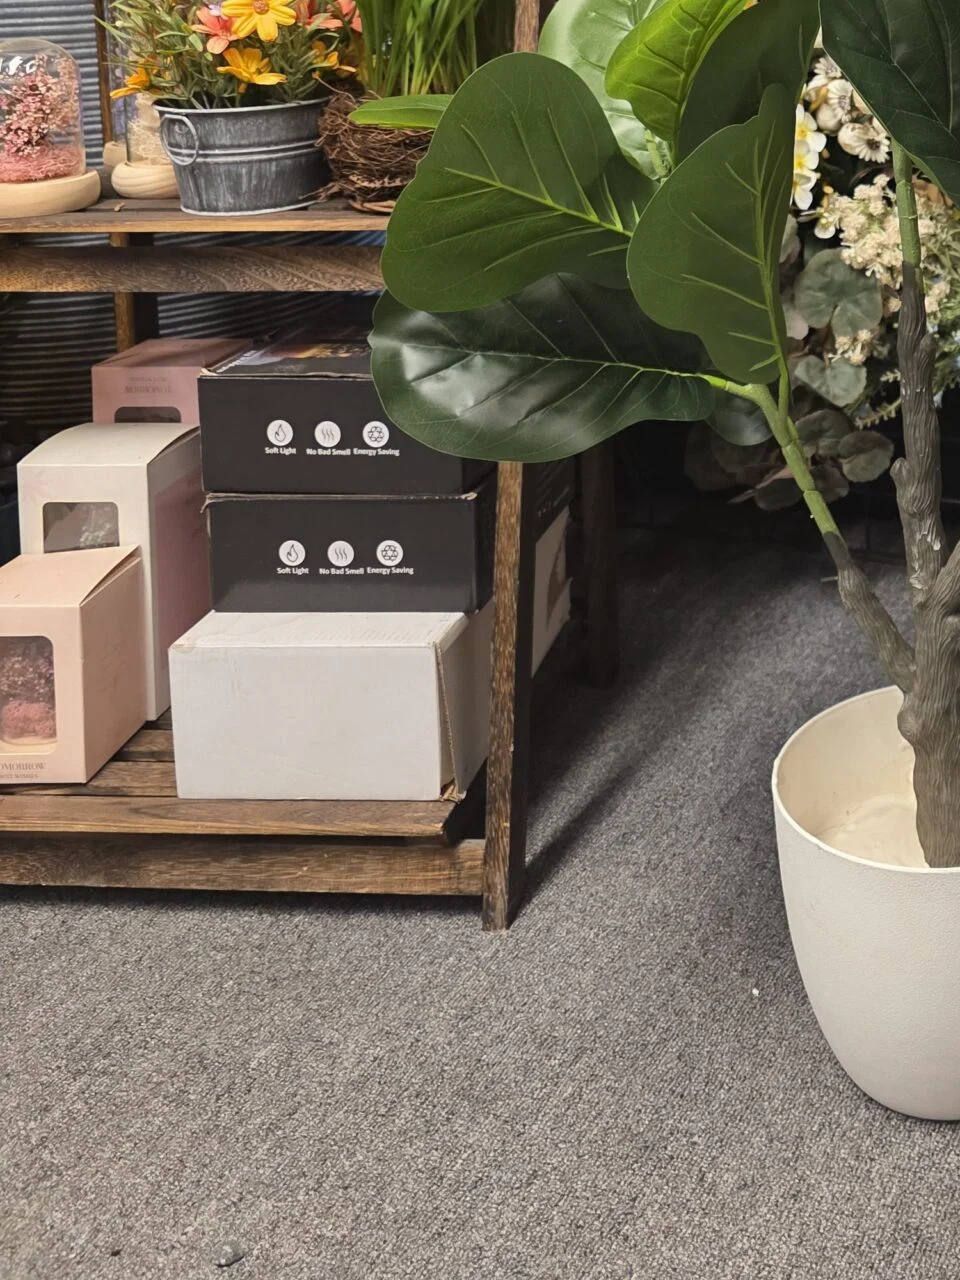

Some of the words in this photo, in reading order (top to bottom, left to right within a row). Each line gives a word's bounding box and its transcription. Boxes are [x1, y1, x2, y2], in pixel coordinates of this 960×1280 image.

[264, 447, 278, 455] Soft
[279, 447, 297, 456] Light
[332, 448, 351, 456] Smell
[353, 448, 376, 457] Energy
[377, 448, 400, 457] Saving
[277, 567, 291, 575] Soft
[292, 567, 309, 575] Light
[319, 567, 330, 575] No
[331, 567, 344, 575] Bad
[345, 567, 364, 575] Smell
[366, 566, 390, 576] Energy
[391, 567, 414, 575] Saving
